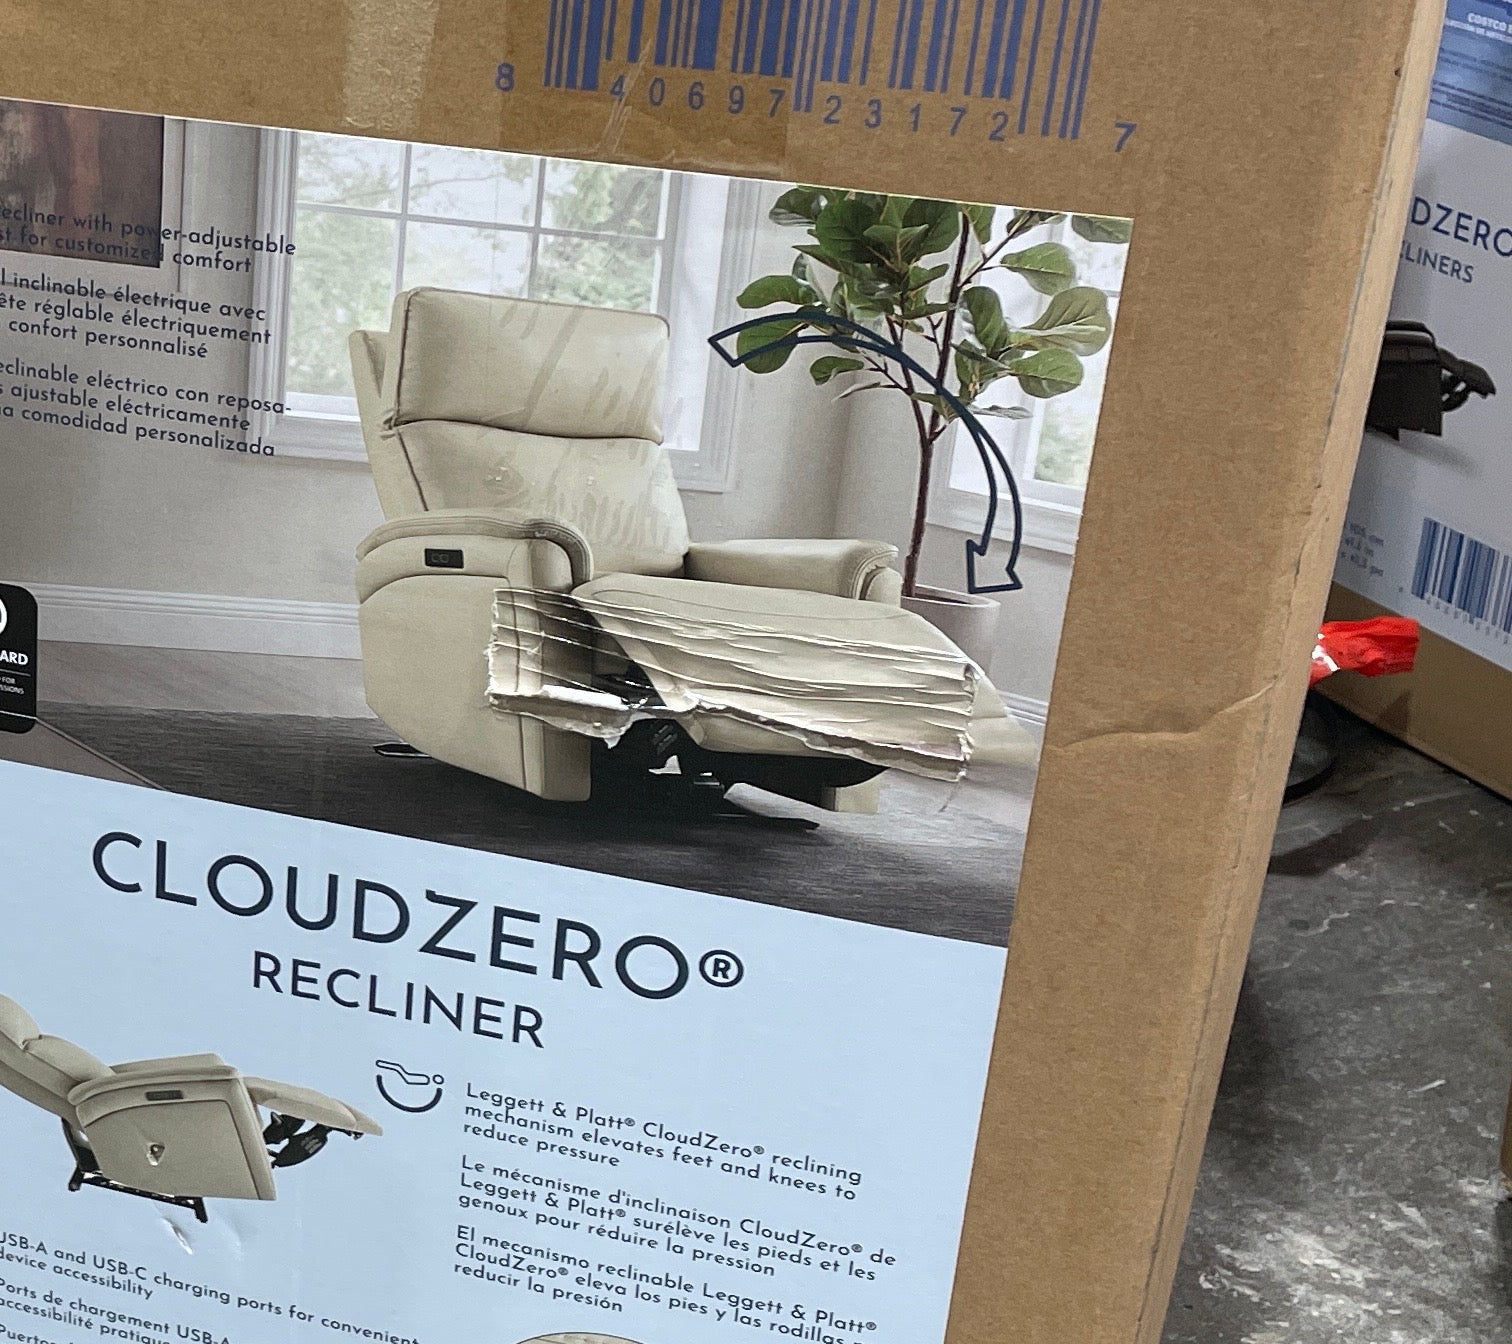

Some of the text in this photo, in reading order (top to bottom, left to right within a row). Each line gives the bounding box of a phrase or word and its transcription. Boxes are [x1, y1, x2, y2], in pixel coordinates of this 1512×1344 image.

[20, 229, 47, 247] for
[55, 236, 164, 262] customized
[173, 251, 252, 273] comfort
[73, 214, 112, 234] with
[121, 222, 296, 256] power-adjustable
[13, 272, 106, 301] inclinable
[113, 284, 212, 315] électrique
[219, 304, 266, 321] avec
[8, 318, 78, 340] confort
[85, 331, 208, 358] personnalisé
[34, 298, 114, 323] réglable
[121, 307, 272, 345] électriquement
[253, 950, 544, 1048] RECLINER
[463, 1123, 620, 1167] reduce pressure
[465, 1105, 856, 1200] mechanism elevates feet and knees to
[466, 1082, 862, 1186] Leggett & Platt® CloudZero® reclining
[53, 1265, 153, 1301] accessibility
[54, 1249, 86, 1265] and
[93, 1254, 147, 1281] USB-C
[153, 1271, 231, 1305] charging
[237, 1297, 282, 1315] ports
[289, 1304, 315, 1323] for
